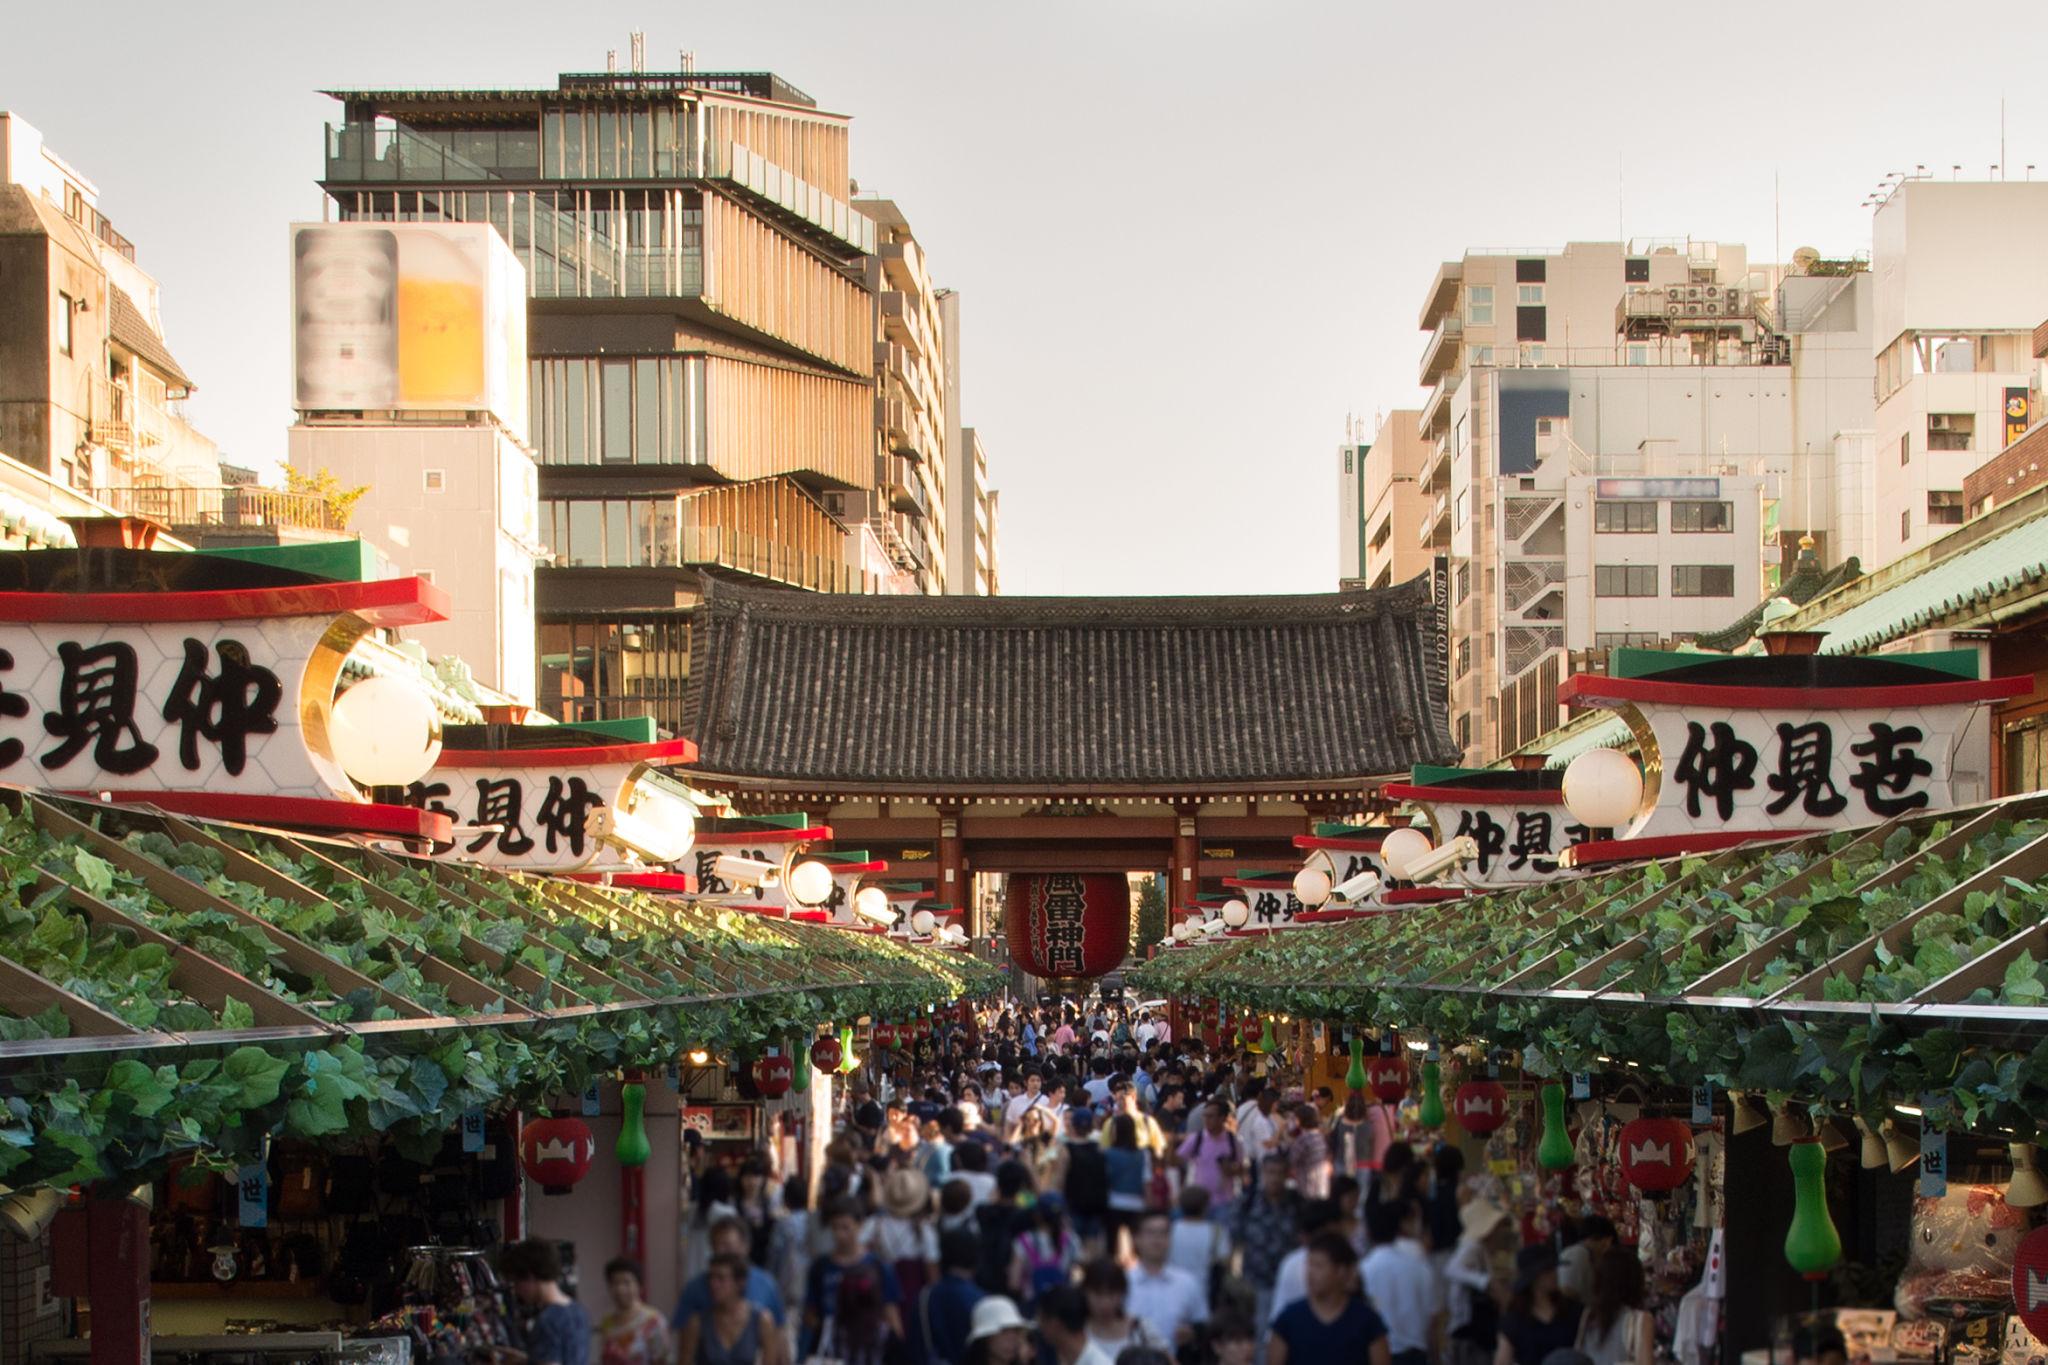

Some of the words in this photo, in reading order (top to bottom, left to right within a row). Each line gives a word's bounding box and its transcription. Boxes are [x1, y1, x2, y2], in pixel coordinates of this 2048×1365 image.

[1435, 570, 1447, 632] CROSTER
[0, 637, 282, 776] 仲見
[1673, 720, 1933, 823] 仲見世
[465, 1116, 482, 1134] 世
[241, 1178, 264, 1204] 世
